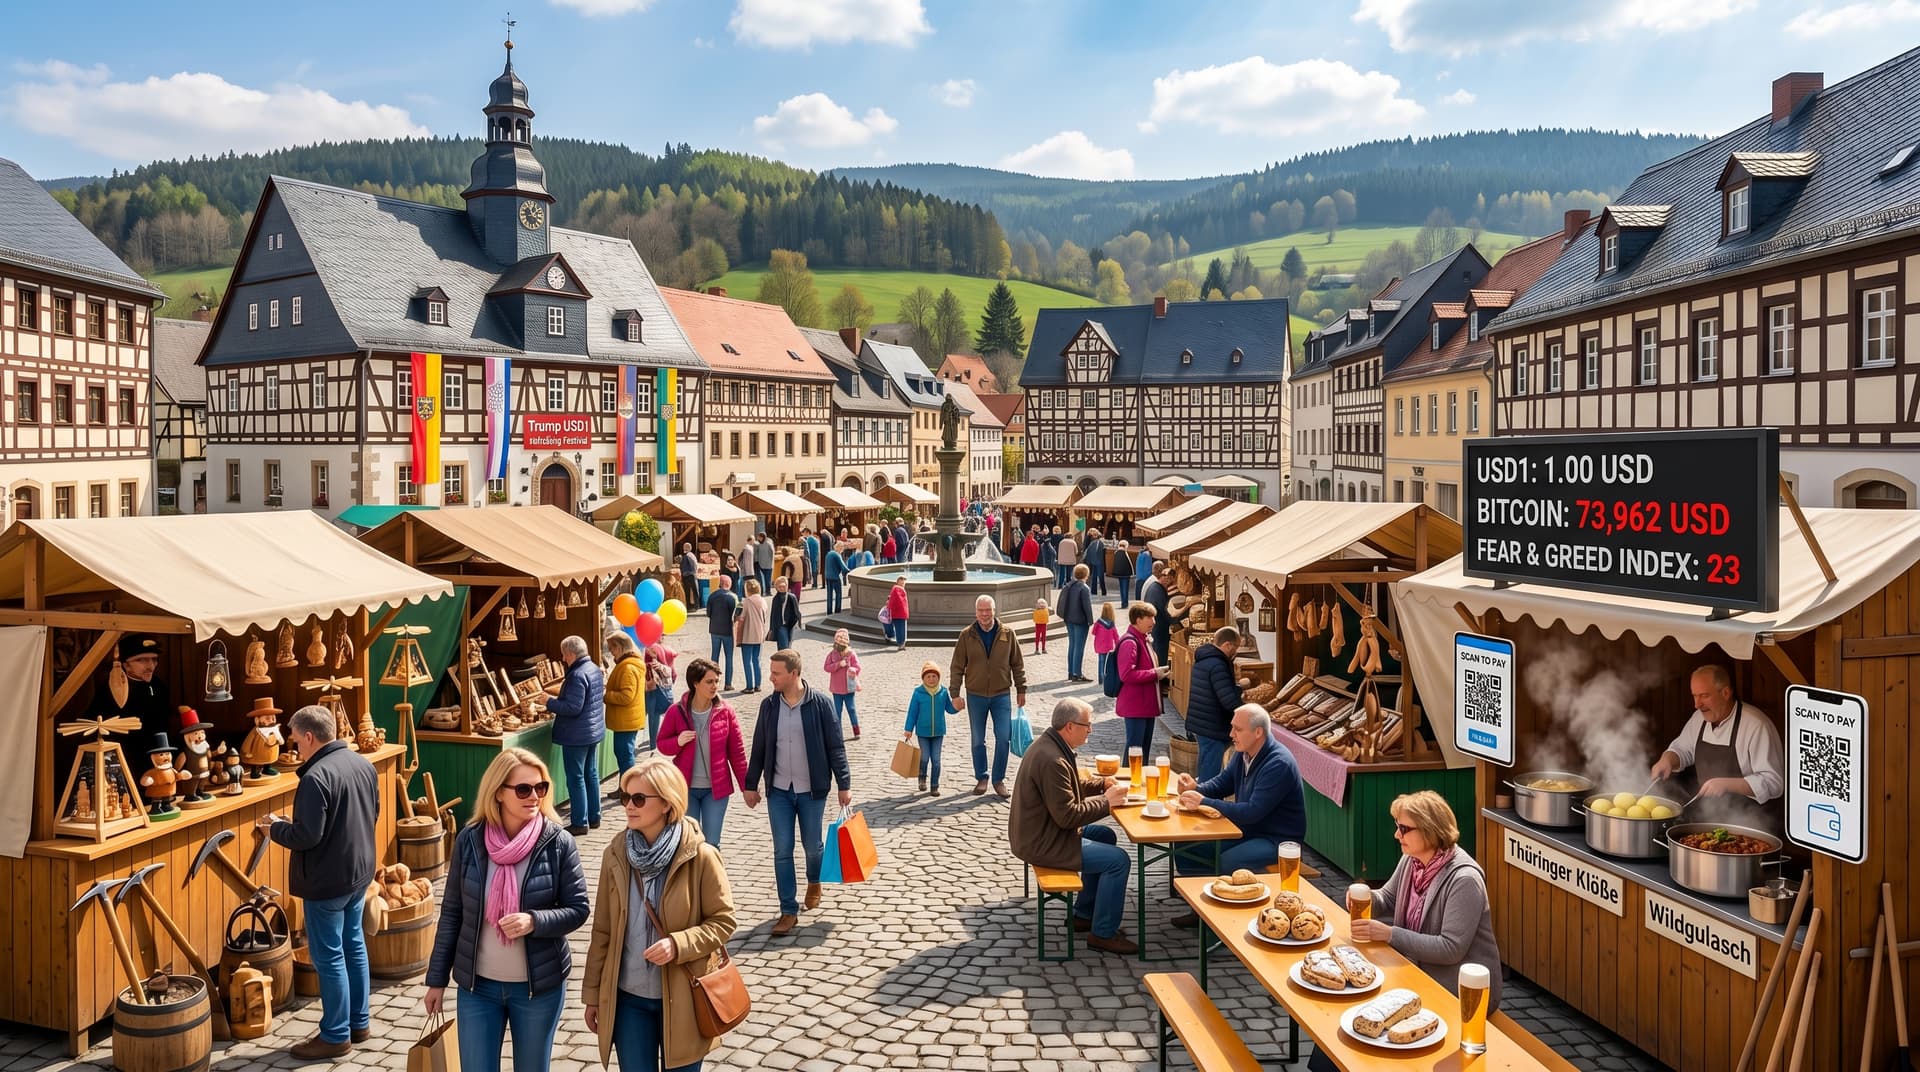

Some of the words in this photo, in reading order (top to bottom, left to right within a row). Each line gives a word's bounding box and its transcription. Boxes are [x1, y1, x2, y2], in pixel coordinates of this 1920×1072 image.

[528, 420, 561, 434] Trump
[564, 420, 588, 432] USD1
[1477, 456, 1537, 483] USD1:
[1545, 455, 1593, 483] 1.00
[1601, 454, 1653, 484] USD
[1477, 498, 1569, 528] BITCOIN:
[1575, 500, 1662, 536] 73,962
[1670, 502, 1730, 536] USD
[1477, 538, 1522, 564] FEAR
[1526, 542, 1540, 566] &
[1545, 543, 1613, 572] GREED
[1619, 548, 1699, 581] INDEX:
[1706, 553, 1741, 585] 23
[1460, 651, 1480, 663] SCAN
[1481, 655, 1491, 665] TO
[1492, 657, 1506, 669] PAY
[1795, 707, 1820, 721] SCAN
[1822, 712, 1835, 724] TO
[1837, 715, 1856, 729] PAY
[1508, 837, 1572, 882] Thüringer
[1576, 868, 1619, 904] Klöße
[1649, 899, 1751, 965] Wildgulasch
